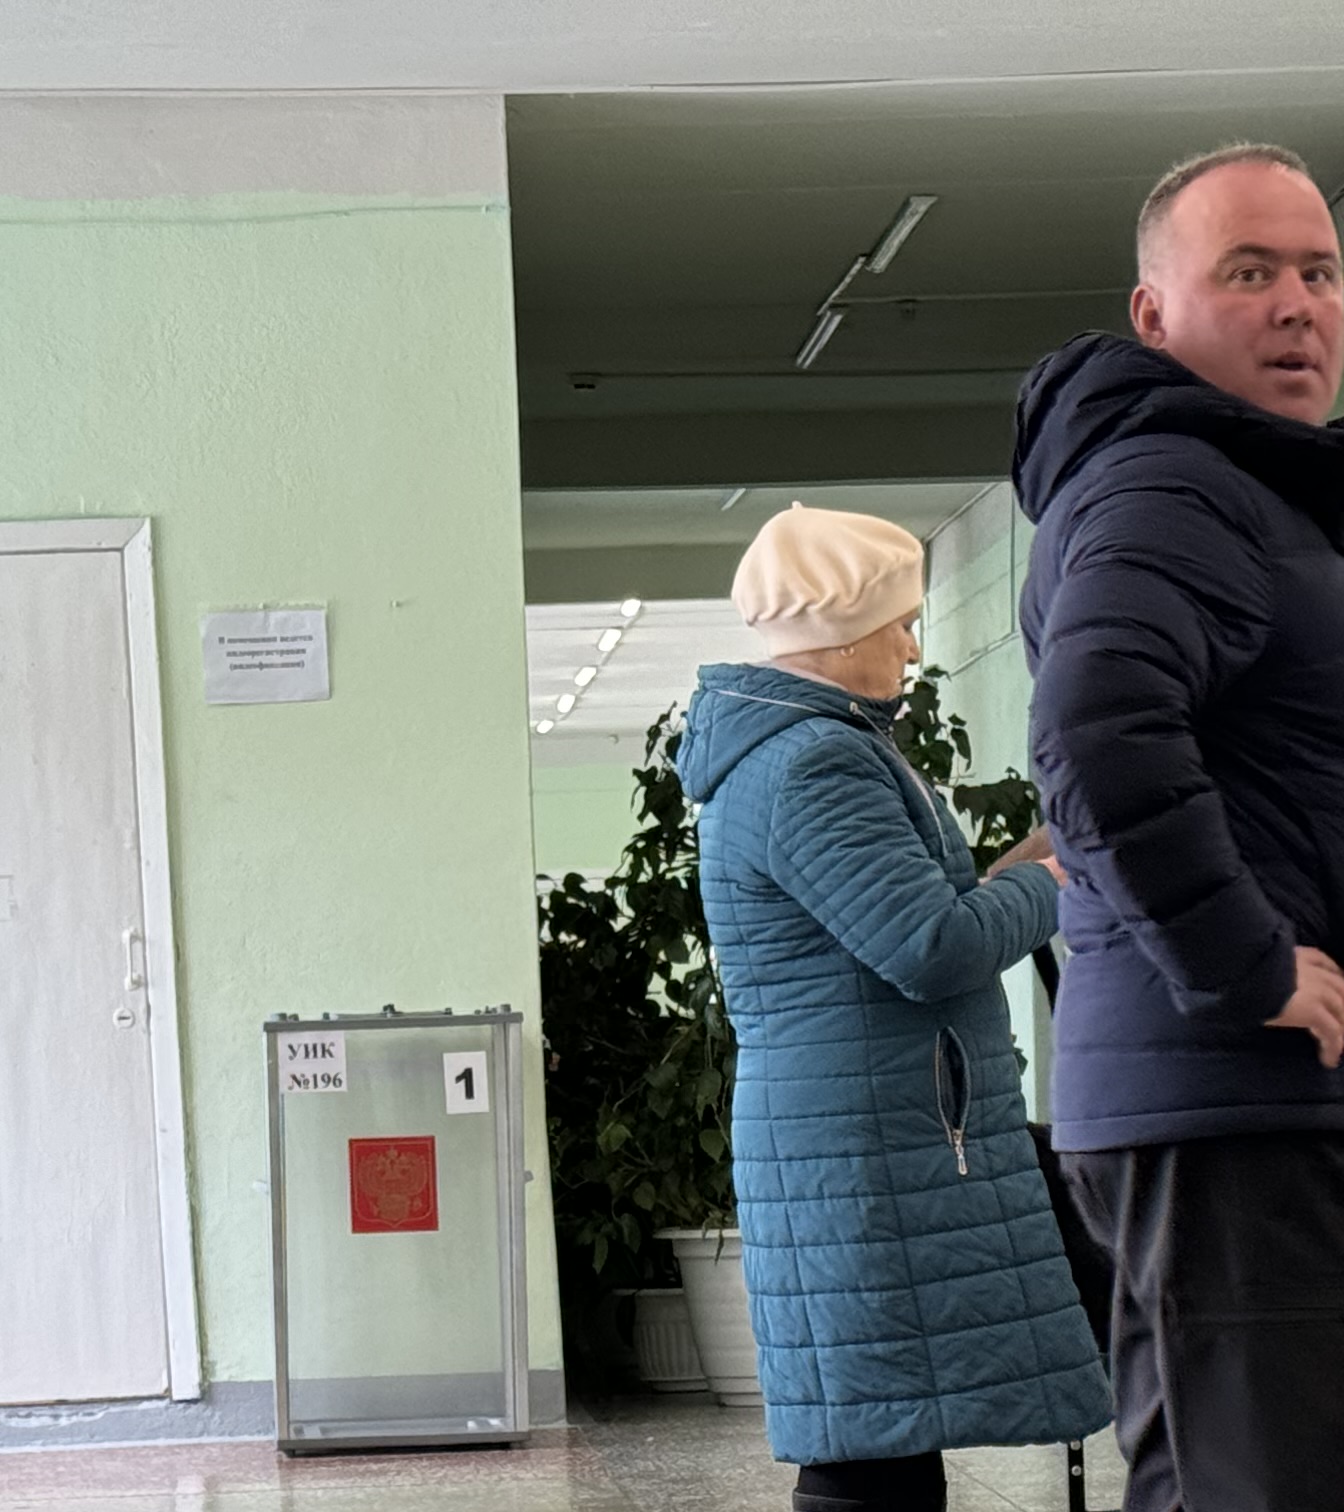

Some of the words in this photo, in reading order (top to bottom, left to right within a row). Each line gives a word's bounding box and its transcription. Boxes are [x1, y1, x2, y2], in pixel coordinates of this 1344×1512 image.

[287, 1042, 335, 1060] УИК
[287, 1072, 343, 1090] №196
[455, 1067, 475, 1100] 1
